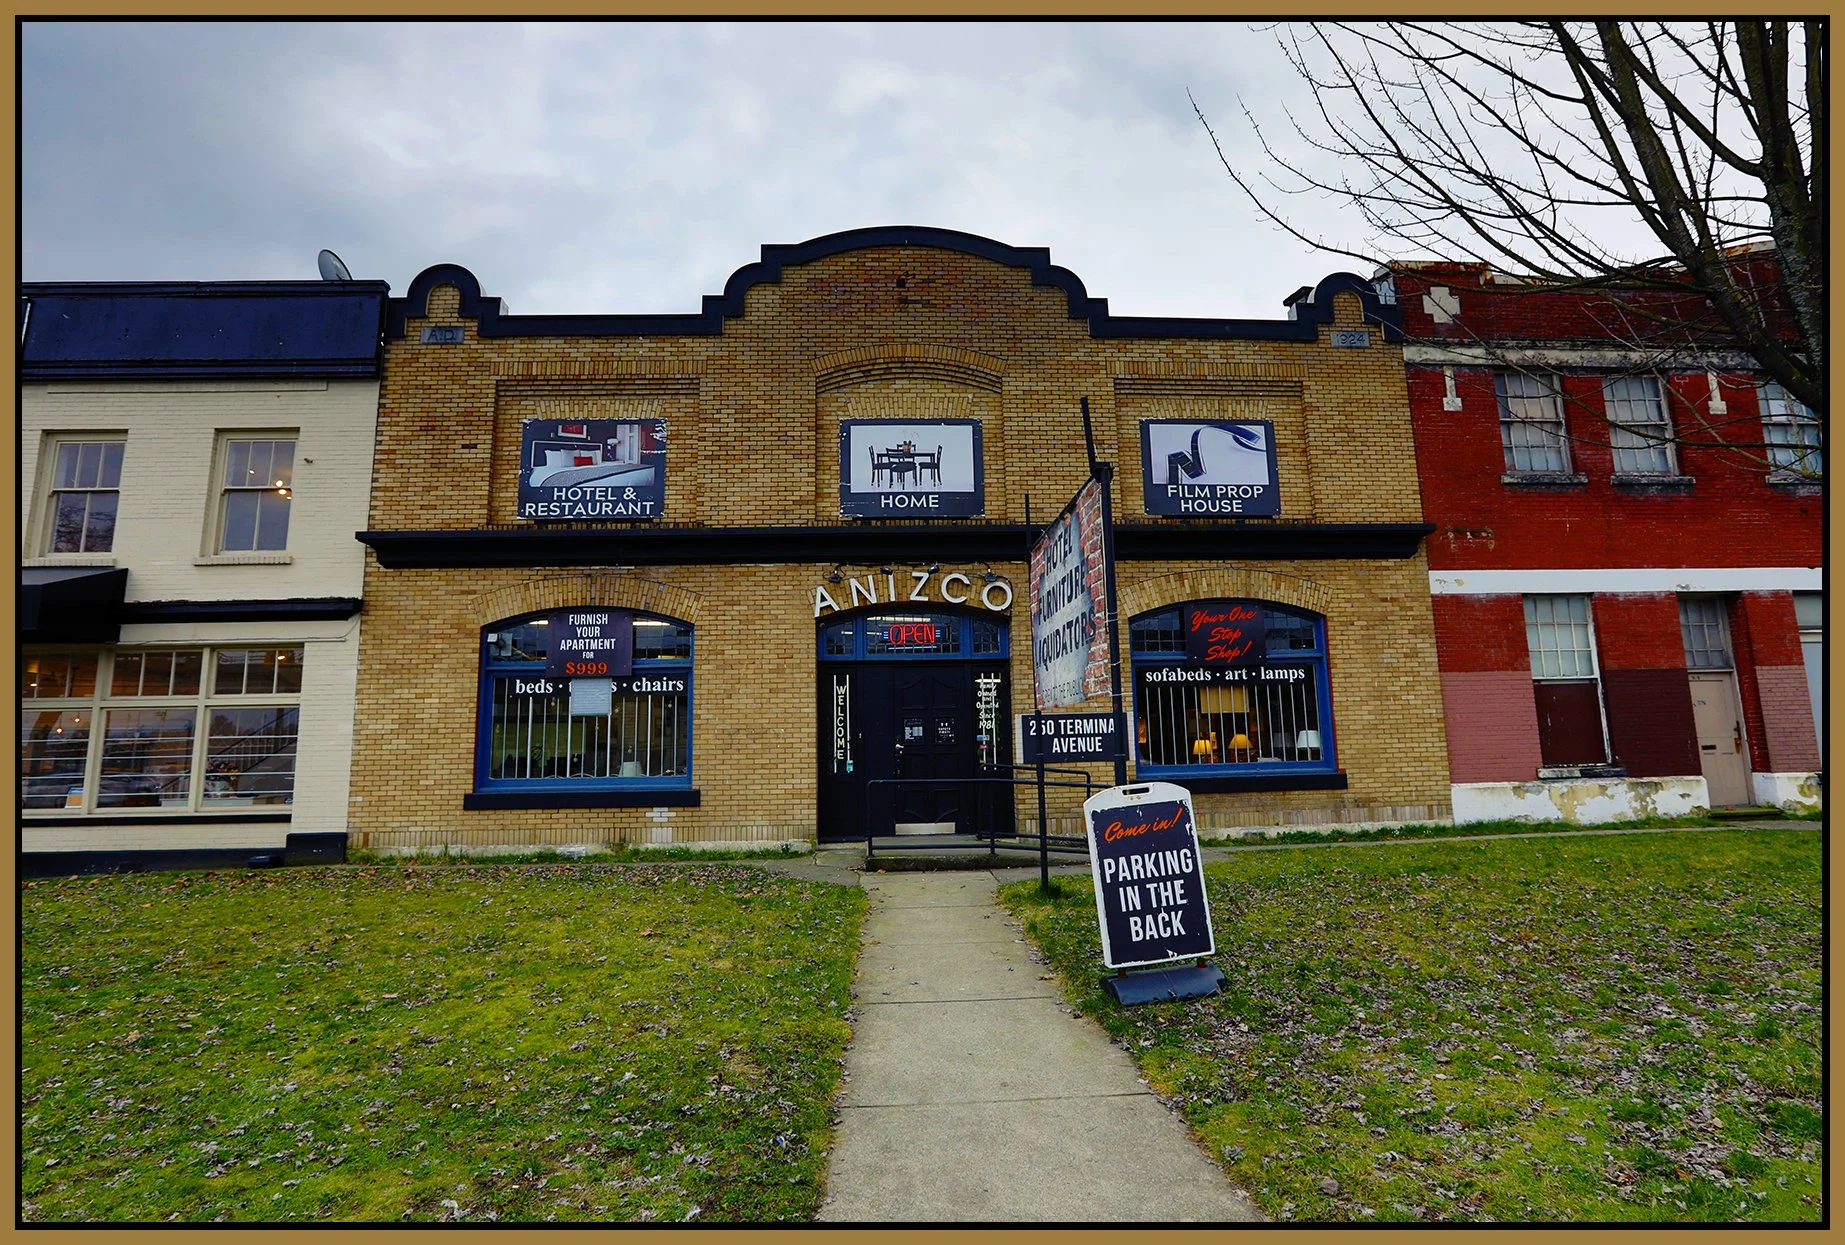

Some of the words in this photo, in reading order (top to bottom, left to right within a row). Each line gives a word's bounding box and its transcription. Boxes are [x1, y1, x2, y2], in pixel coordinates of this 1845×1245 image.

[1336, 333, 1365, 345] 1924
[553, 487, 617, 500] HOTEL
[623, 487, 636, 500] &
[1167, 485, 1210, 498] FILM
[1216, 486, 1264, 498] PROP
[525, 502, 655, 516] RESTAURANT
[881, 494, 939, 508] HOME
[1180, 499, 1243, 512] HOUSE
[1045, 525, 1073, 577] HOTEL
[814, 571, 1013, 618] ANIZCO
[1038, 559, 1086, 626] FURNITURE
[569, 614, 608, 625] FURNISH
[1190, 609, 1227, 632] Your
[1228, 605, 1257, 623] One
[576, 626, 600, 638] YOUR
[889, 623, 936, 645] OPEN
[1034, 606, 1097, 671] LIQUIDATORS
[1207, 626, 1242, 644] Stop
[560, 638, 616, 650] APARTMENT
[1204, 640, 1253, 663] Shop!
[582, 651, 594, 659] FOR
[565, 661, 608, 675] $999
[1145, 667, 1212, 682] sofabeds
[1224, 667, 1249, 681] art
[1260, 666, 1305, 683] lamps
[515, 679, 553, 694] beds
[632, 676, 684, 692] chairs
[836, 685, 847, 760] WELCOME
[1058, 718, 1115, 735] TERMINA
[1052, 736, 1103, 753] AVENUE
[1104, 821, 1150, 842] Come
[1152, 807, 1184, 832] in!
[1103, 848, 1194, 884] PARKING
[1119, 885, 1141, 912] IN
[1146, 879, 1188, 909] THE
[1129, 910, 1186, 942] BACK
